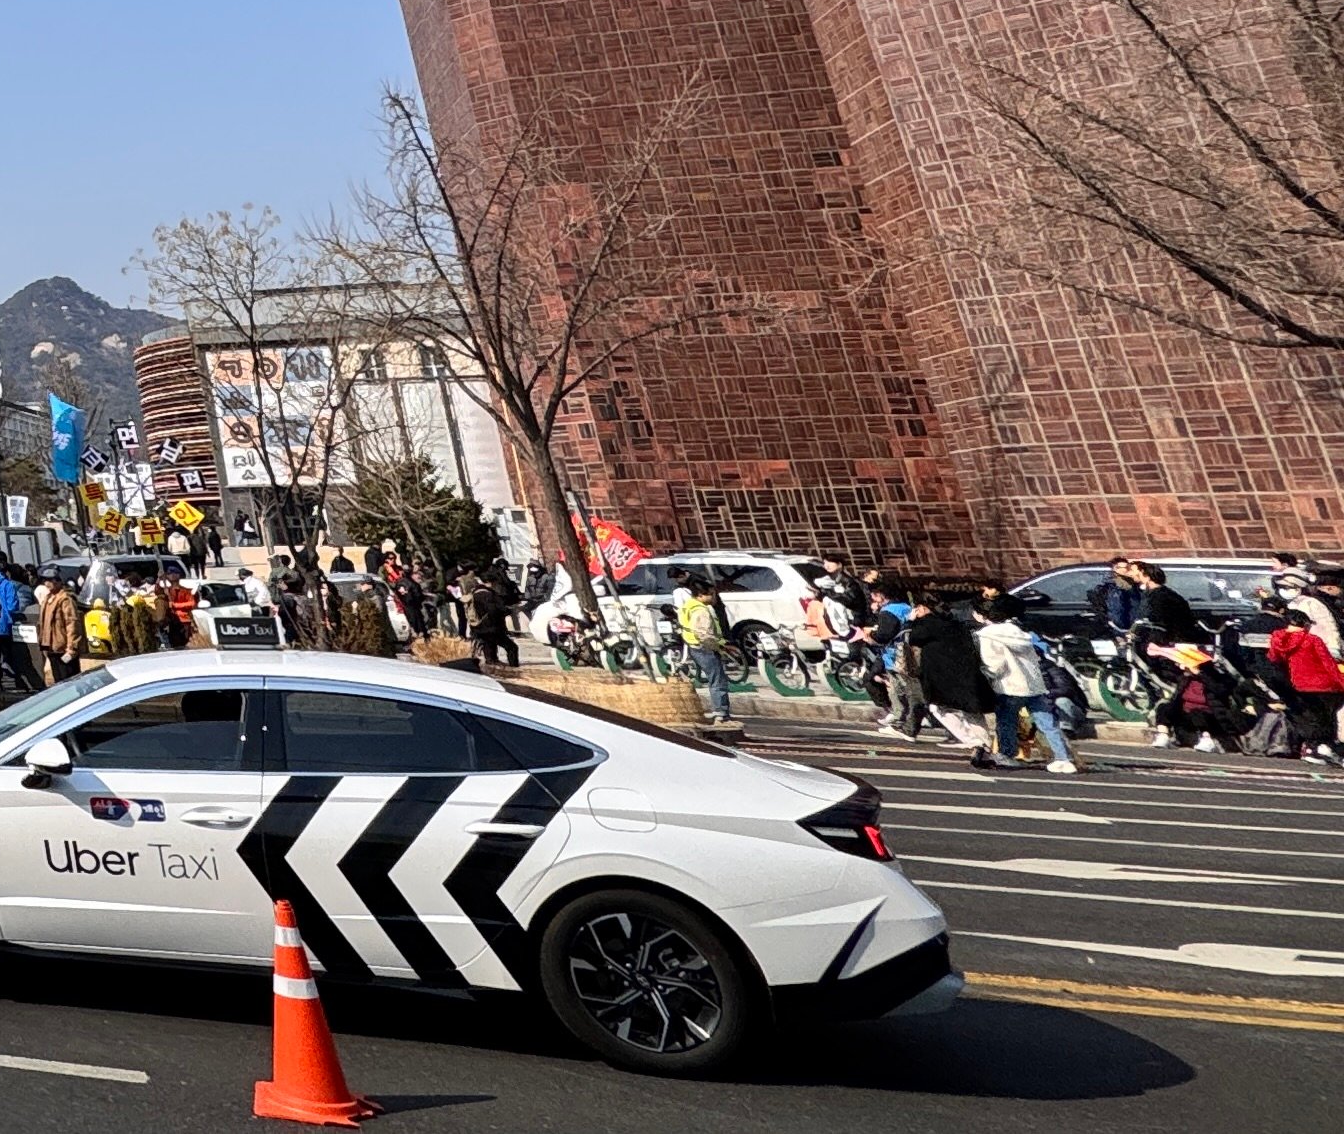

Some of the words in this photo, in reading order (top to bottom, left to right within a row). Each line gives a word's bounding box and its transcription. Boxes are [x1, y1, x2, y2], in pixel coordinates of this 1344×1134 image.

[140, 519, 161, 543] 부
[219, 623, 250, 635] Uber
[252, 623, 275, 636] Taxi
[43, 839, 140, 876] Uber
[147, 843, 220, 880] Taxi
